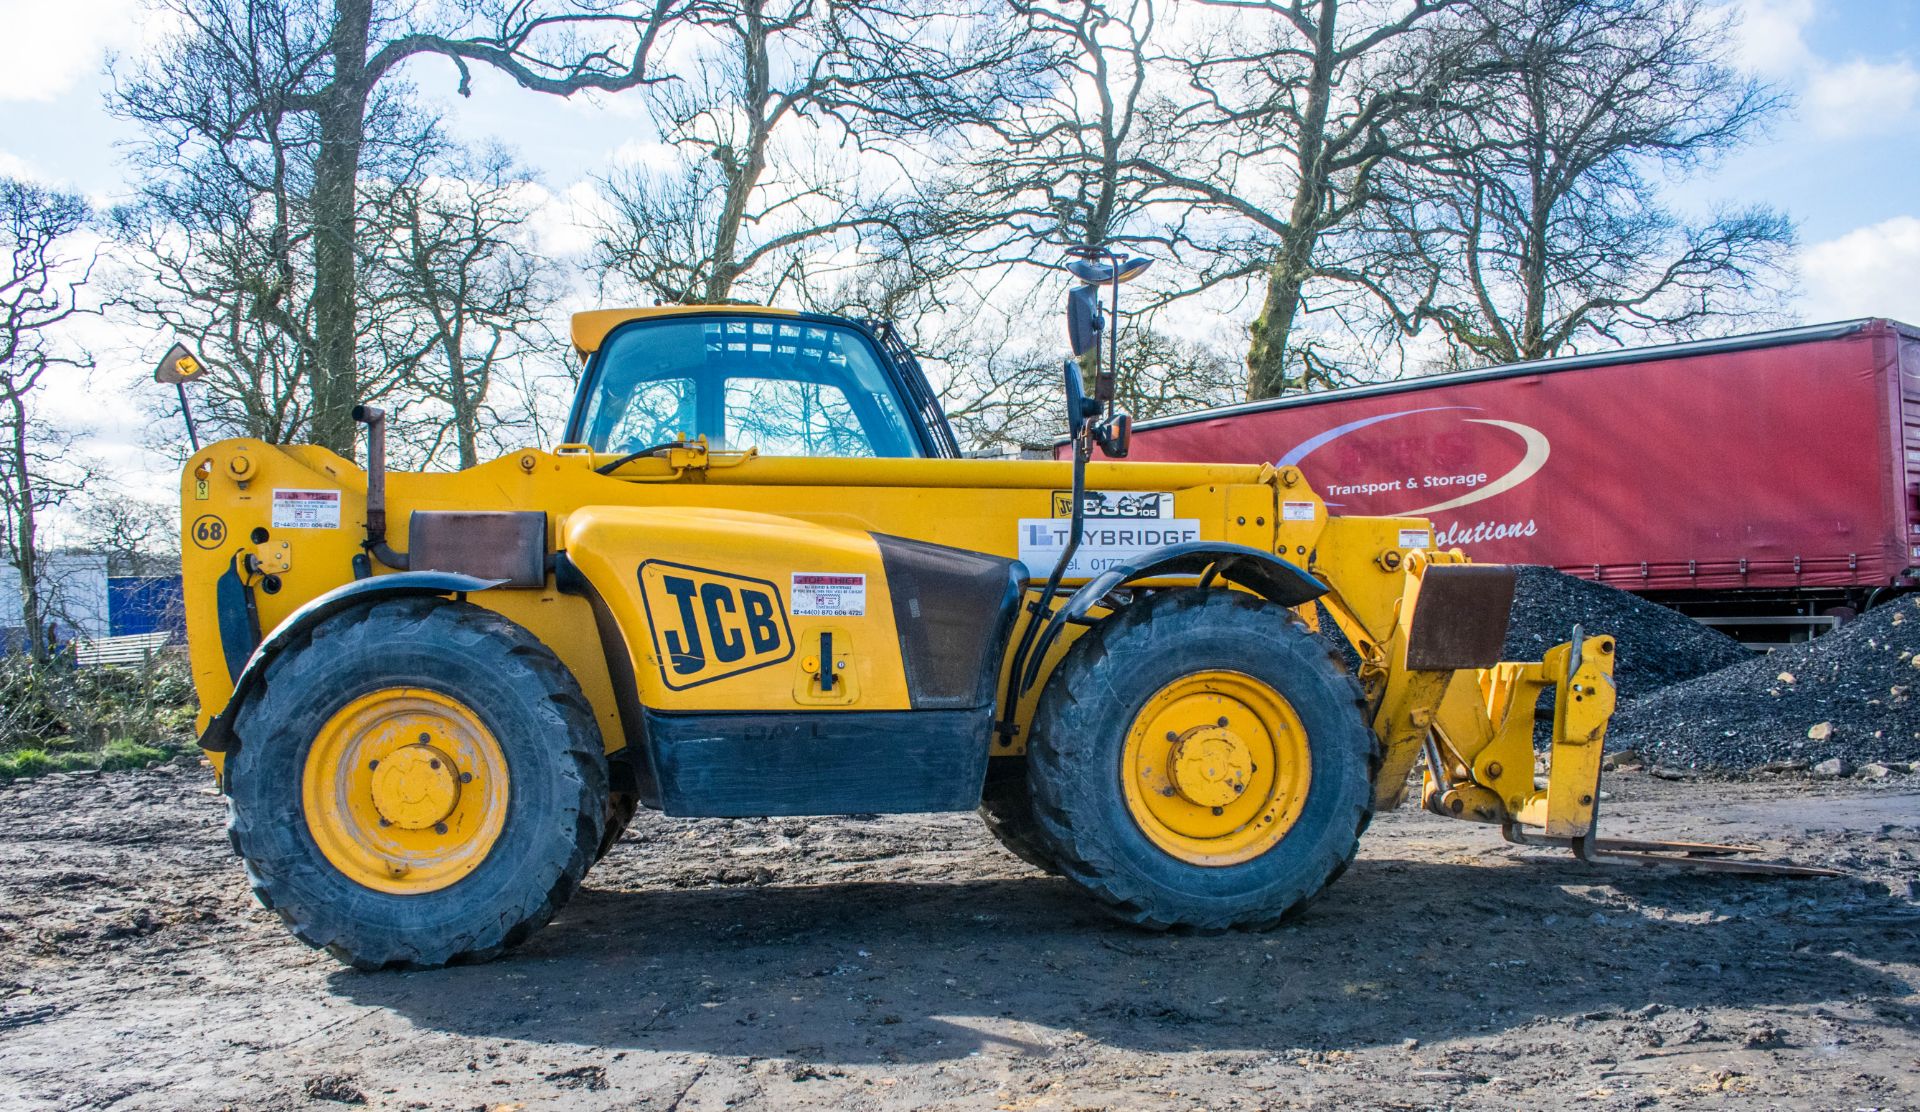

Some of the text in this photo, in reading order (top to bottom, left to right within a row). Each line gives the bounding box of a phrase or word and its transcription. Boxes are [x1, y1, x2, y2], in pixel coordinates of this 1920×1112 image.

[1327, 473, 1488, 496] Transport & Storage
[197, 522, 222, 541] 68
[1053, 530, 1196, 546] TYBRIDGE
[1430, 519, 1538, 547] olutions
[662, 575, 781, 675] JCB
